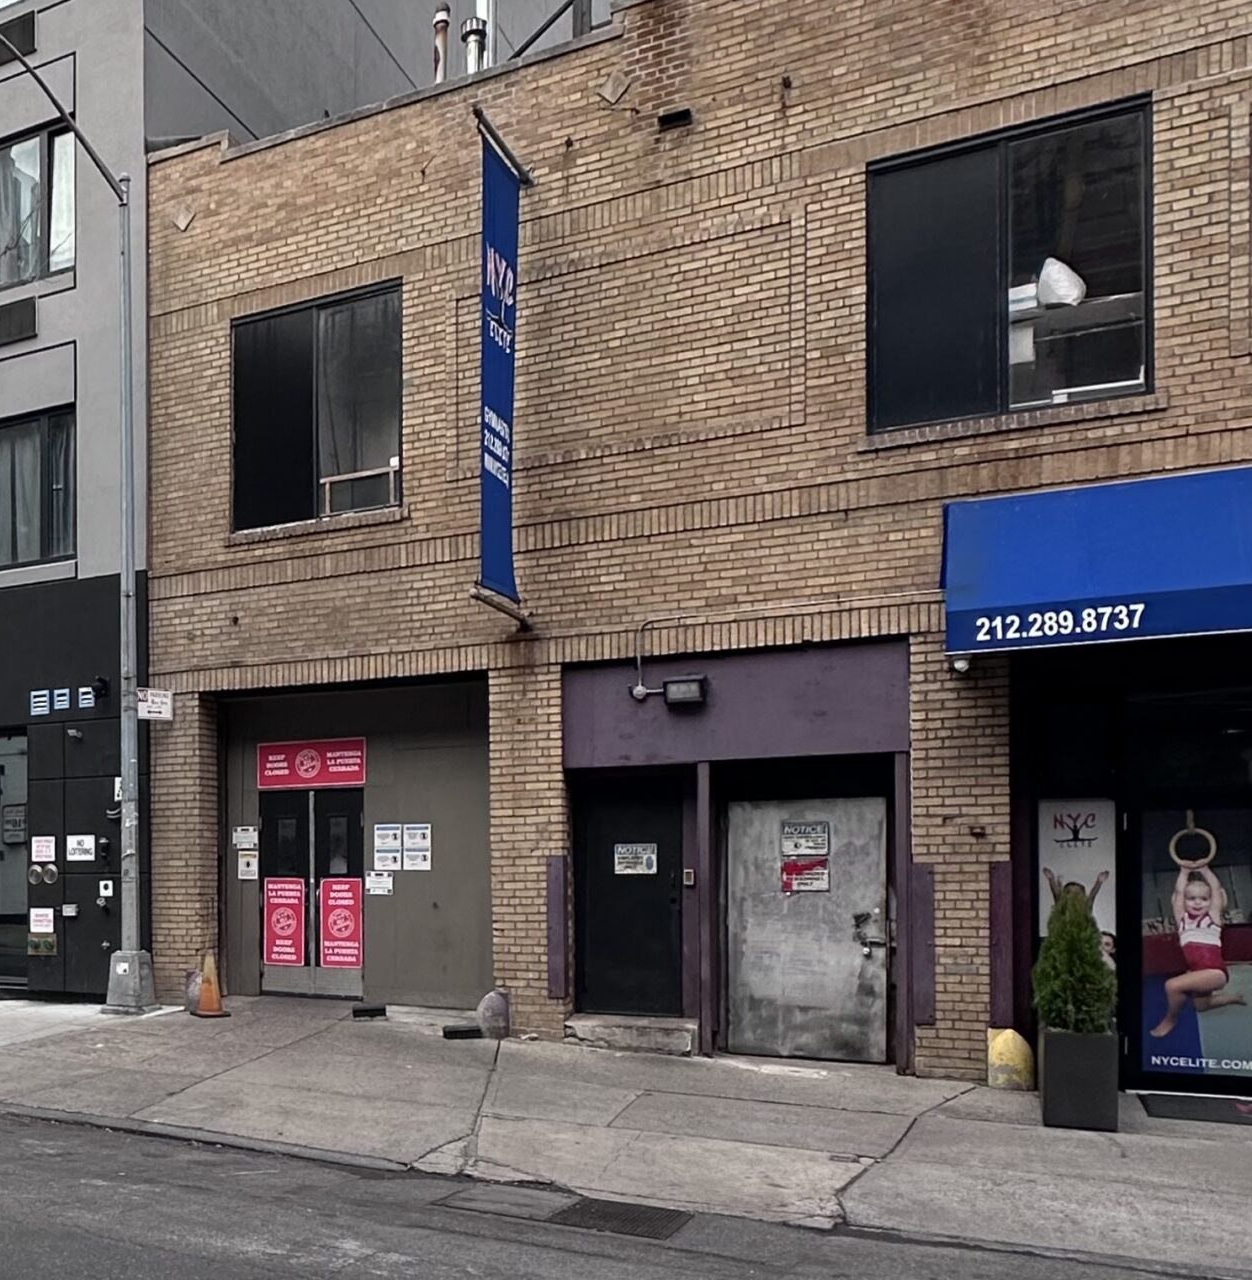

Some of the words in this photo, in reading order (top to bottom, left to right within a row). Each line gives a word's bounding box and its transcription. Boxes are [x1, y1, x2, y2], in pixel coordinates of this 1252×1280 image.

[976, 603, 1145, 641] 212.289.8737
[1053, 813, 1096, 829] NYC
[1151, 1056, 1252, 1070] NYCELITE.COM
